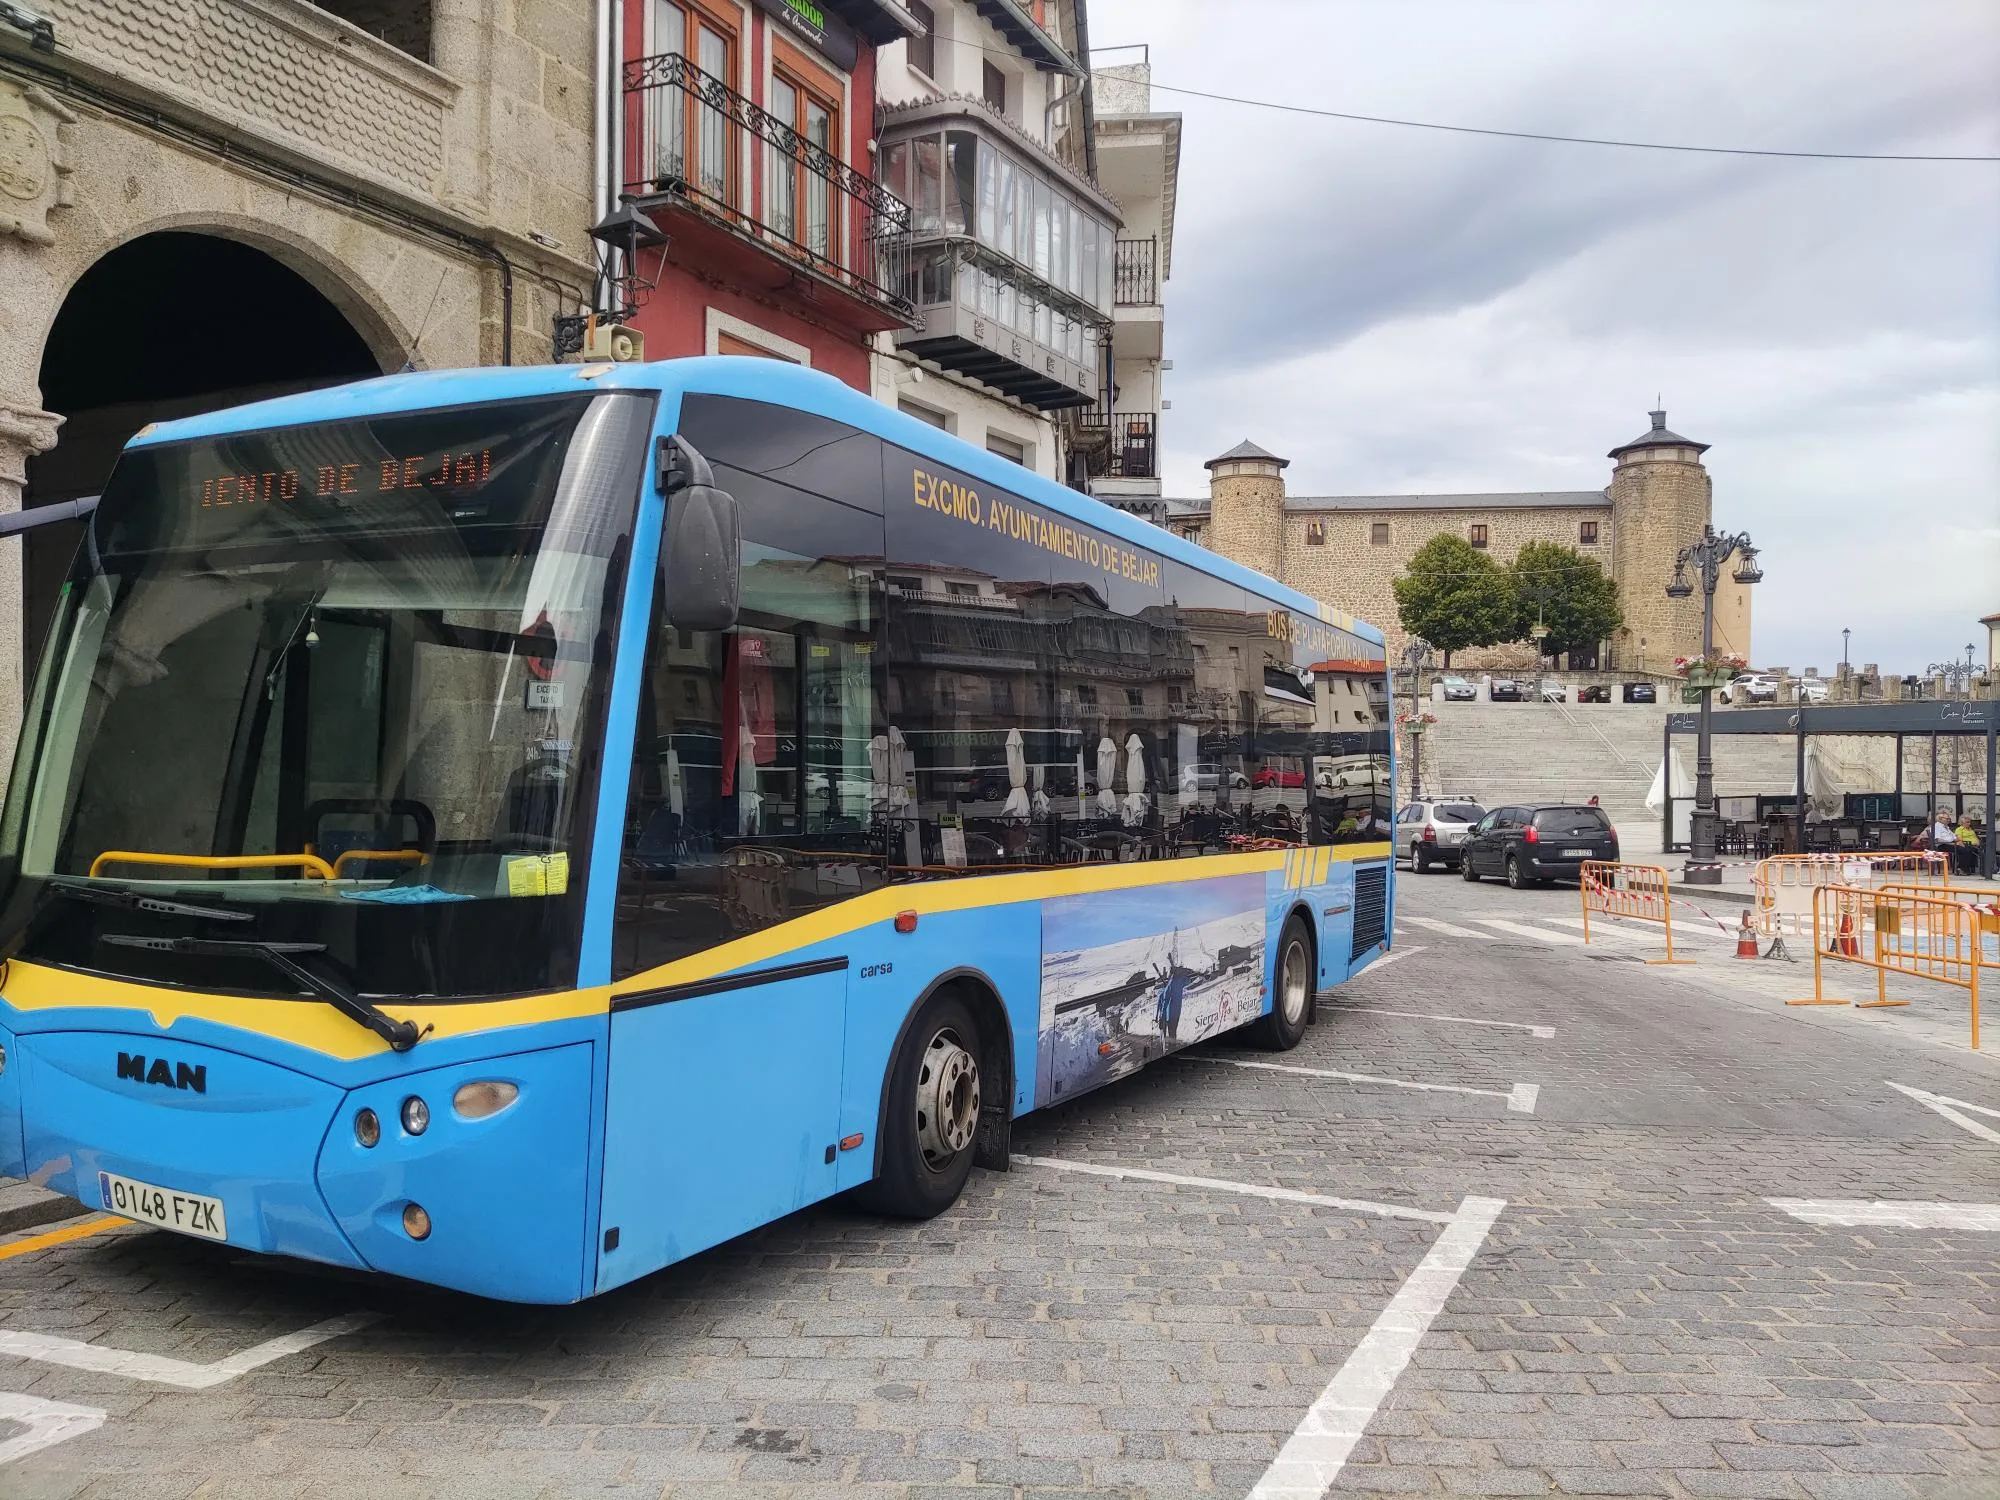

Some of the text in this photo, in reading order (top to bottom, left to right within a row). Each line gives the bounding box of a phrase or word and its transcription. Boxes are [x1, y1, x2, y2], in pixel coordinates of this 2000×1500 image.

[317, 463, 360, 496] DE
[913, 468, 1160, 588] EXCMO. AYUNTAMIENTO DE BÉJAR
[1267, 609, 1371, 671] BUS DE PLATAFORMA BAJA
[860, 962, 893, 978] carsa
[1195, 1011, 1218, 1029] Sierra
[1237, 997, 1257, 1012] Béjar
[117, 1052, 207, 1094] MAN
[114, 1181, 219, 1233] 0148 FZK
